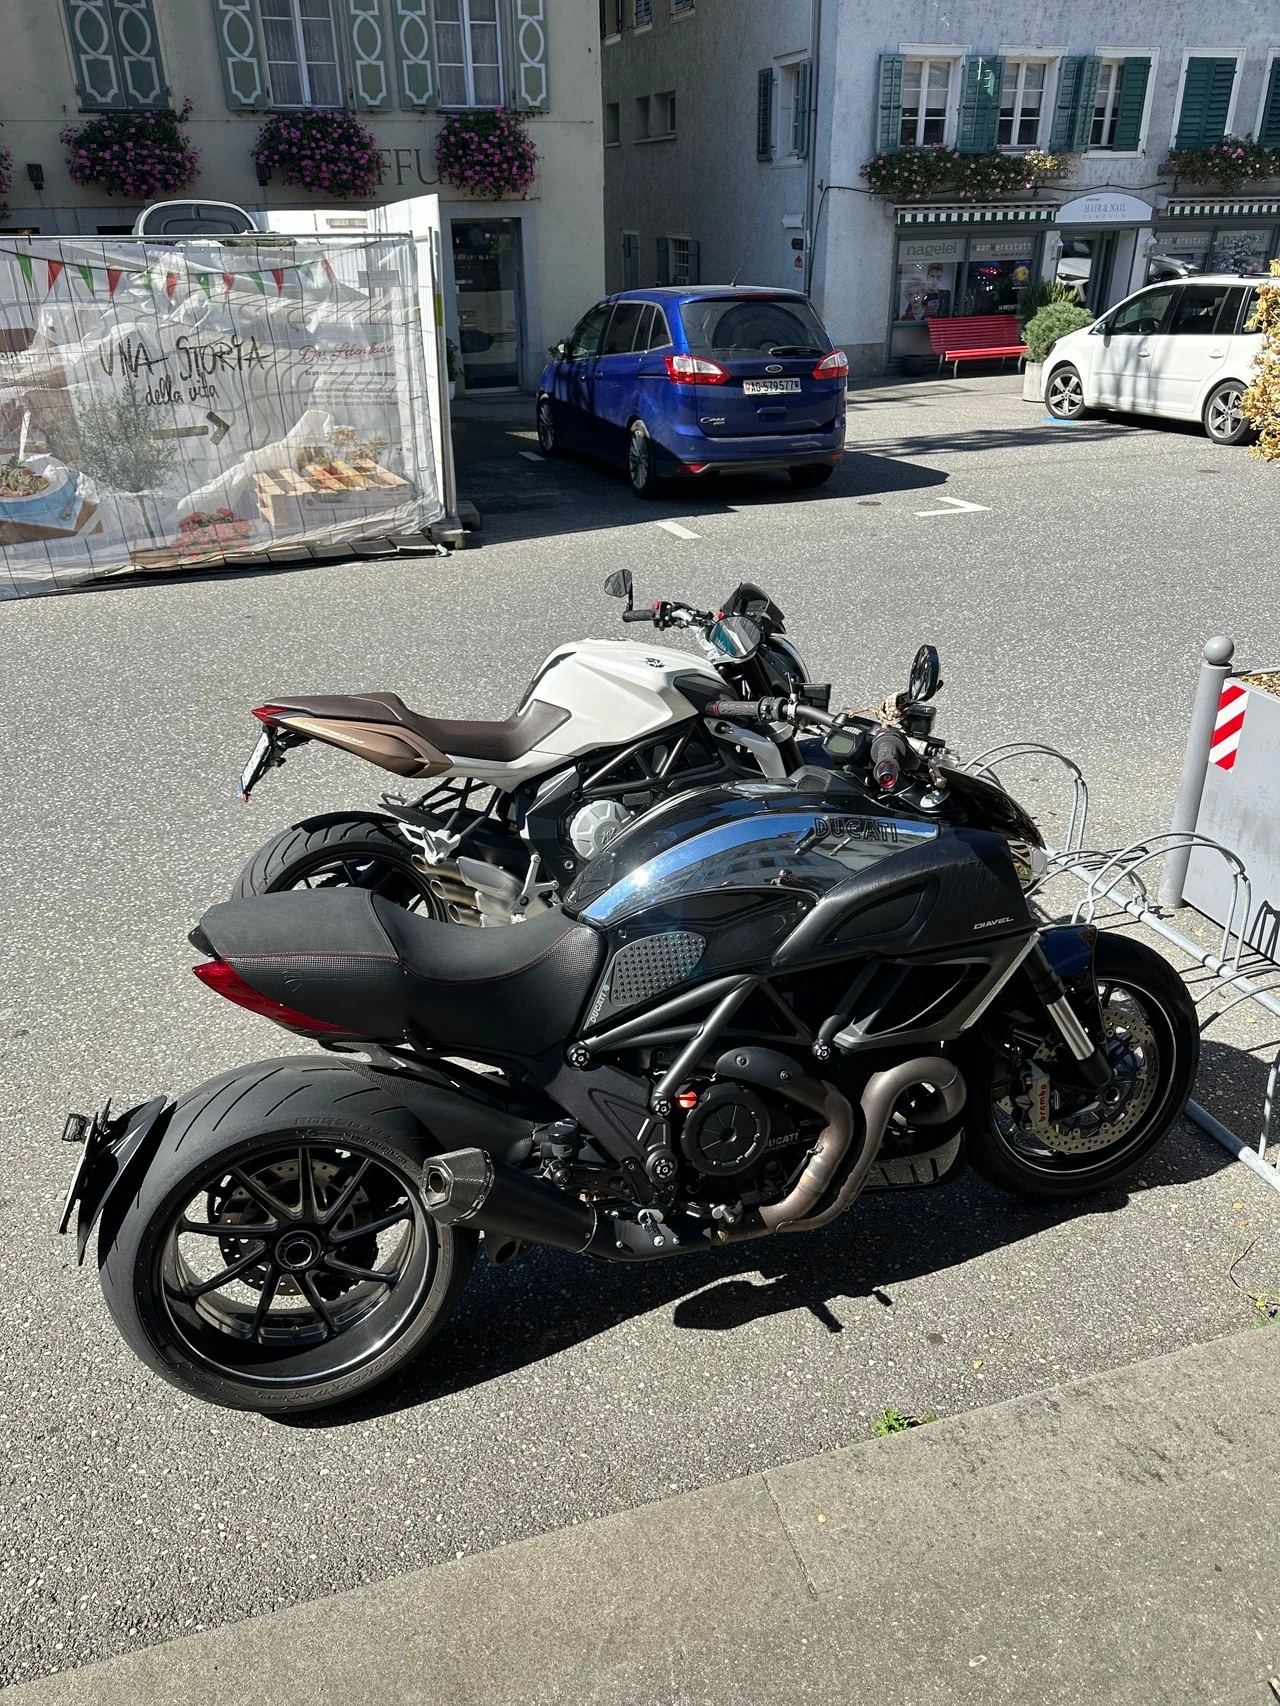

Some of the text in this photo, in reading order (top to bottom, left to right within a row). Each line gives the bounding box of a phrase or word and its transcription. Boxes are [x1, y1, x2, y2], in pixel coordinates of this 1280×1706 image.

[377, 149, 451, 186] FFU
[1084, 204, 1102, 213] HAIR
[1109, 203, 1127, 212] NAIL
[906, 242, 957, 256] nagelei
[99, 334, 271, 381] UNA STORIA
[146, 374, 220, 406] della vita
[814, 817, 898, 843] DUCATI
[973, 916, 1014, 930] DIAVEL
[590, 990, 608, 1024] DUCATI
[1038, 1083, 1047, 1123] brembo
[767, 1131, 799, 1147] UCATI
